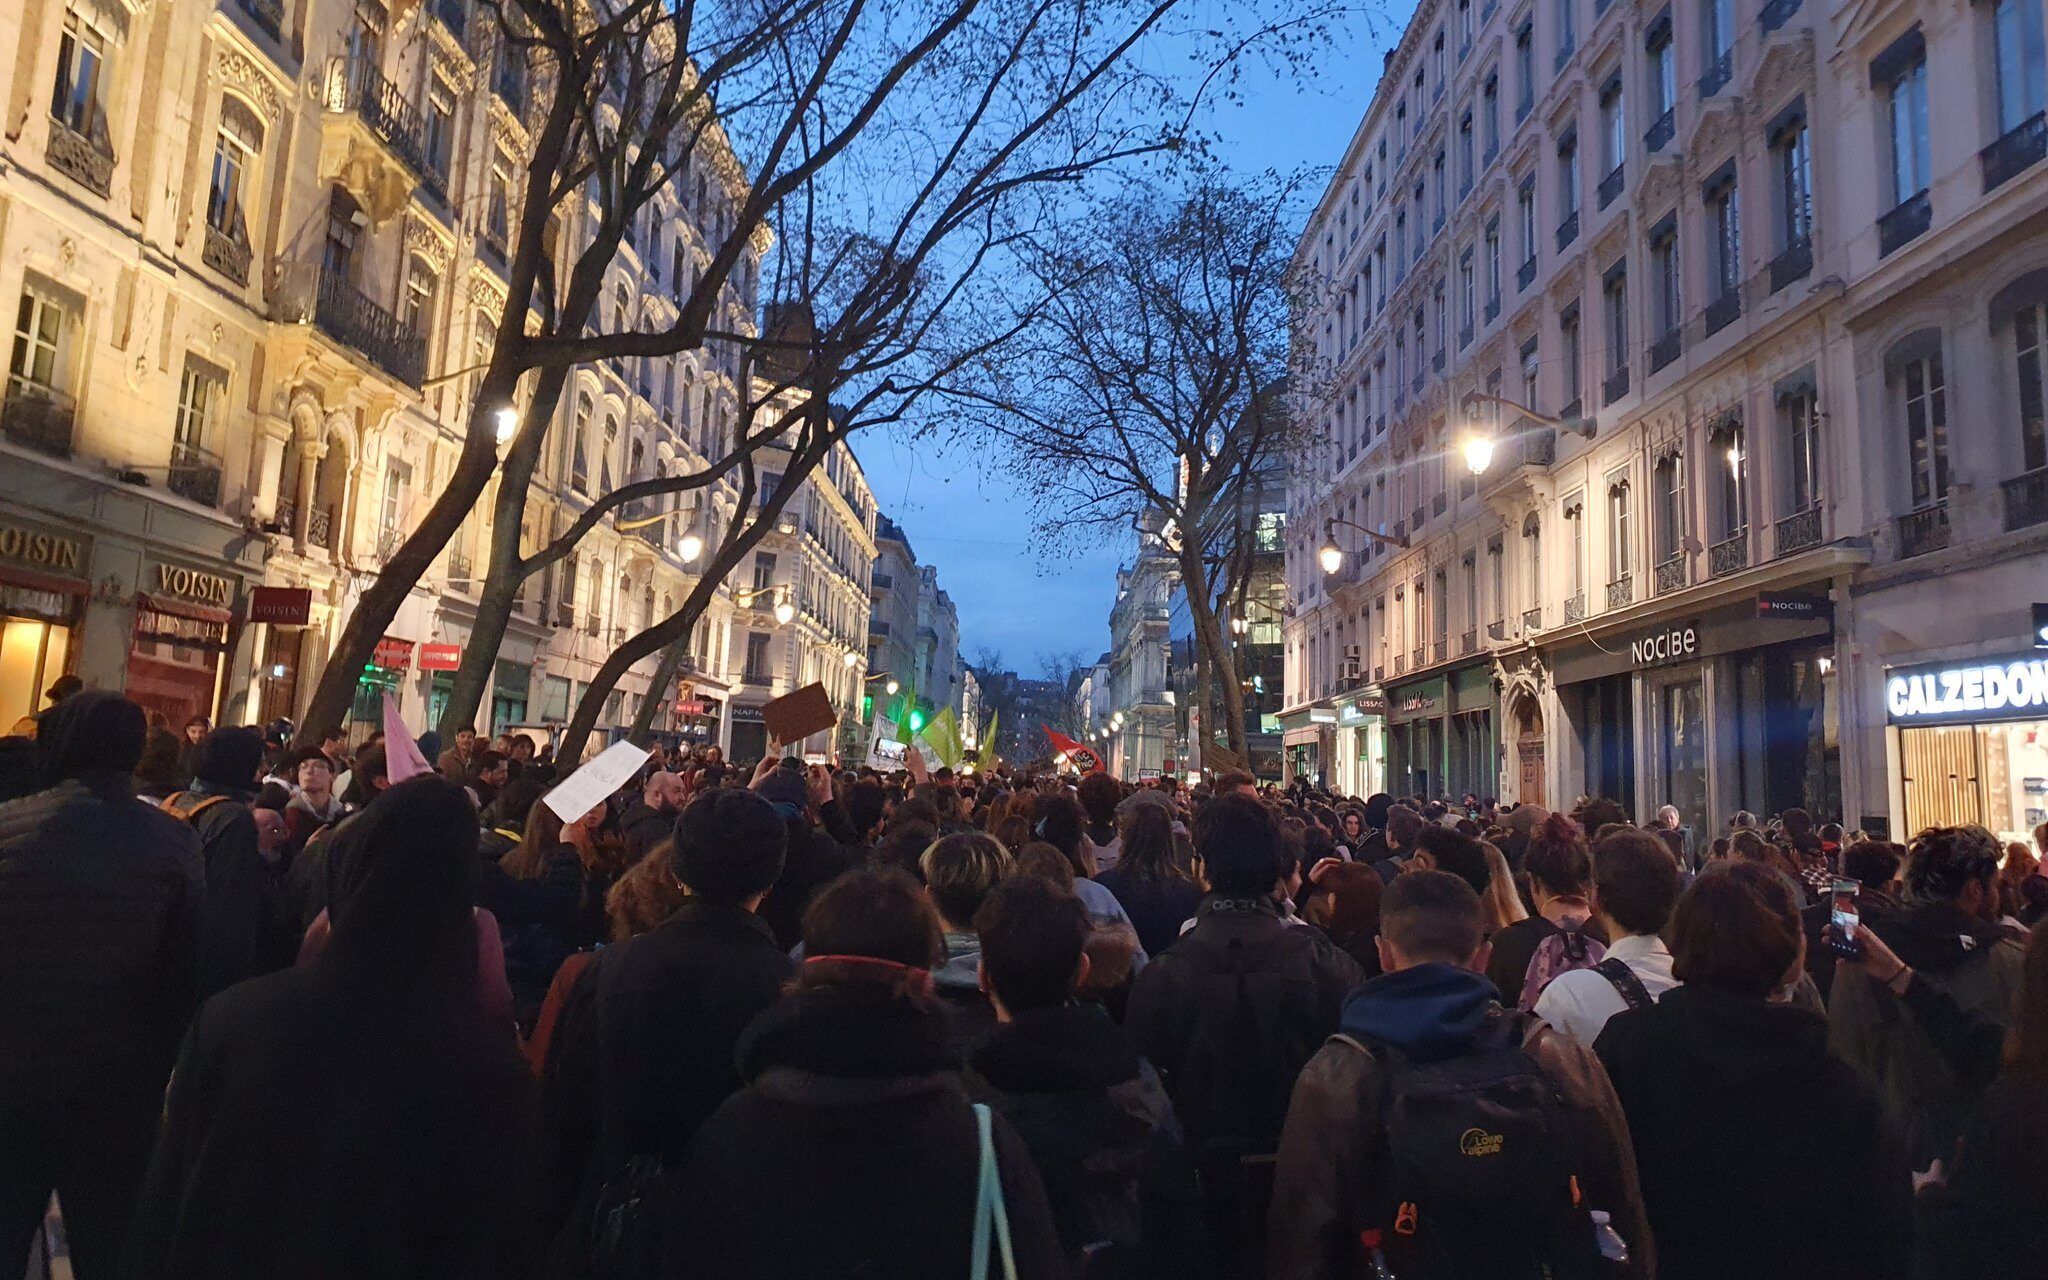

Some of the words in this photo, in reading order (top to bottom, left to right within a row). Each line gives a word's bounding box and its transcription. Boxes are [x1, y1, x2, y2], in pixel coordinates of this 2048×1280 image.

[159, 564, 228, 603] VOISIN
[256, 605, 300, 616] VOISIN
[1888, 660, 2048, 717] CALZEDON
[1359, 700, 1384, 708] LISSAC
